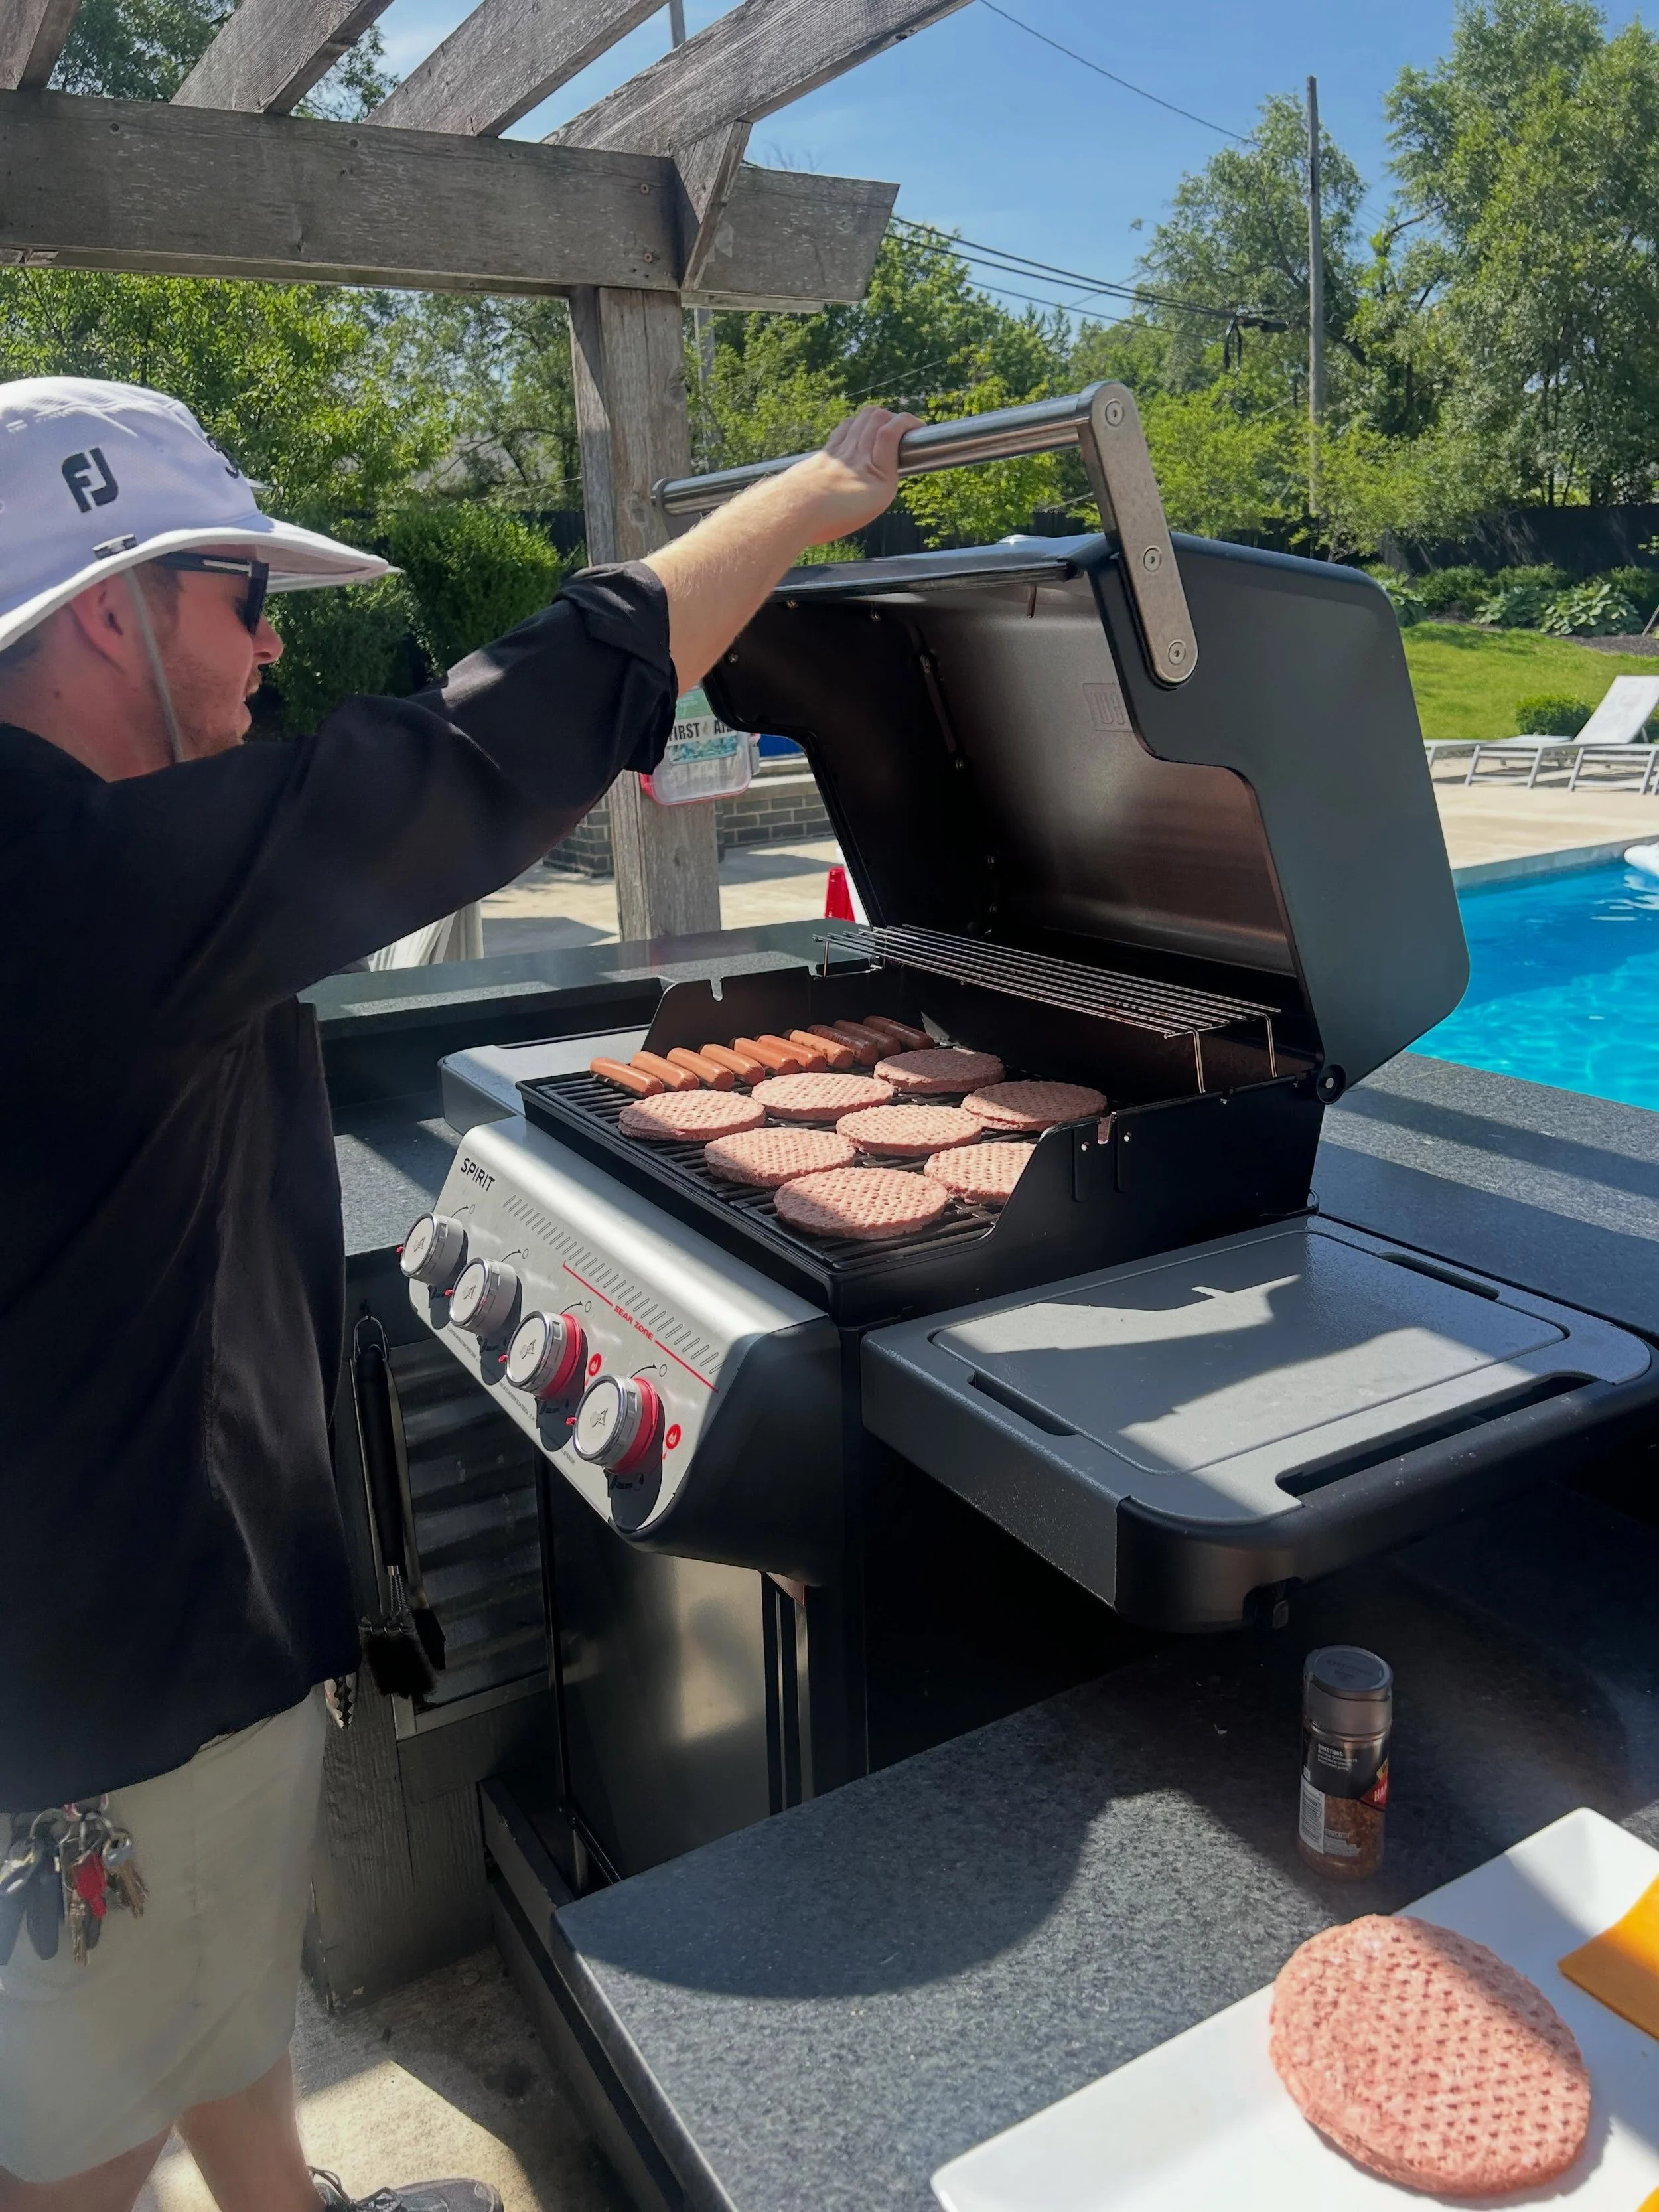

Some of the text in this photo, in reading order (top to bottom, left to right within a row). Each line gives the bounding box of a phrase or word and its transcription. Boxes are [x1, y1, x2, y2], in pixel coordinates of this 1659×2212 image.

[461, 1157, 496, 1192] SPIRIT
[614, 1305, 654, 1341] SEAR ZONE
